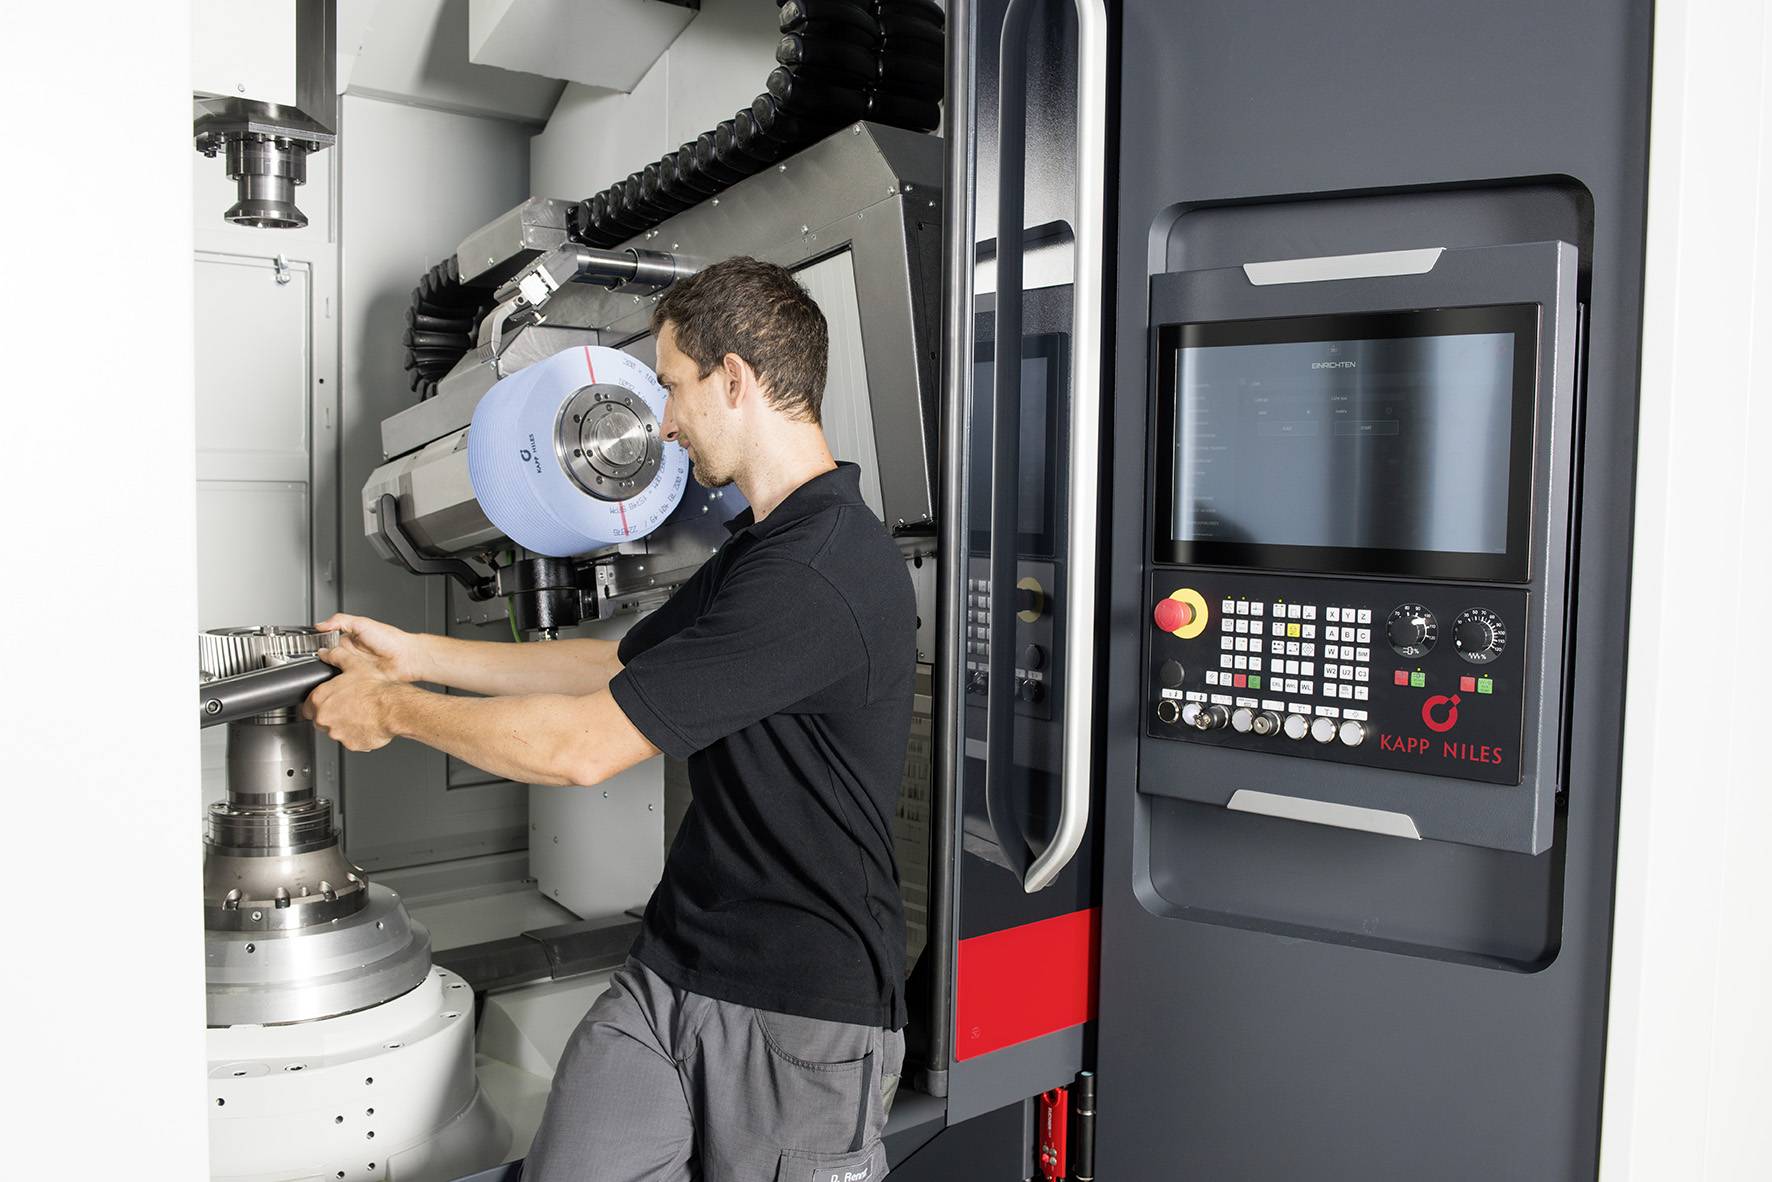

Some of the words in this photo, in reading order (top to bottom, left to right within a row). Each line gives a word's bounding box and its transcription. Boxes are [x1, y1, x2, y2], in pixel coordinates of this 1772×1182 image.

[623, 358, 635, 369] 300
[645, 374, 656, 386] 160
[1311, 361, 1356, 369] EINRICHTEN
[529, 434, 538, 454] NILES
[534, 456, 543, 474] KAPP
[1380, 734, 1430, 755] KAPP
[1443, 741, 1503, 764] NILES
